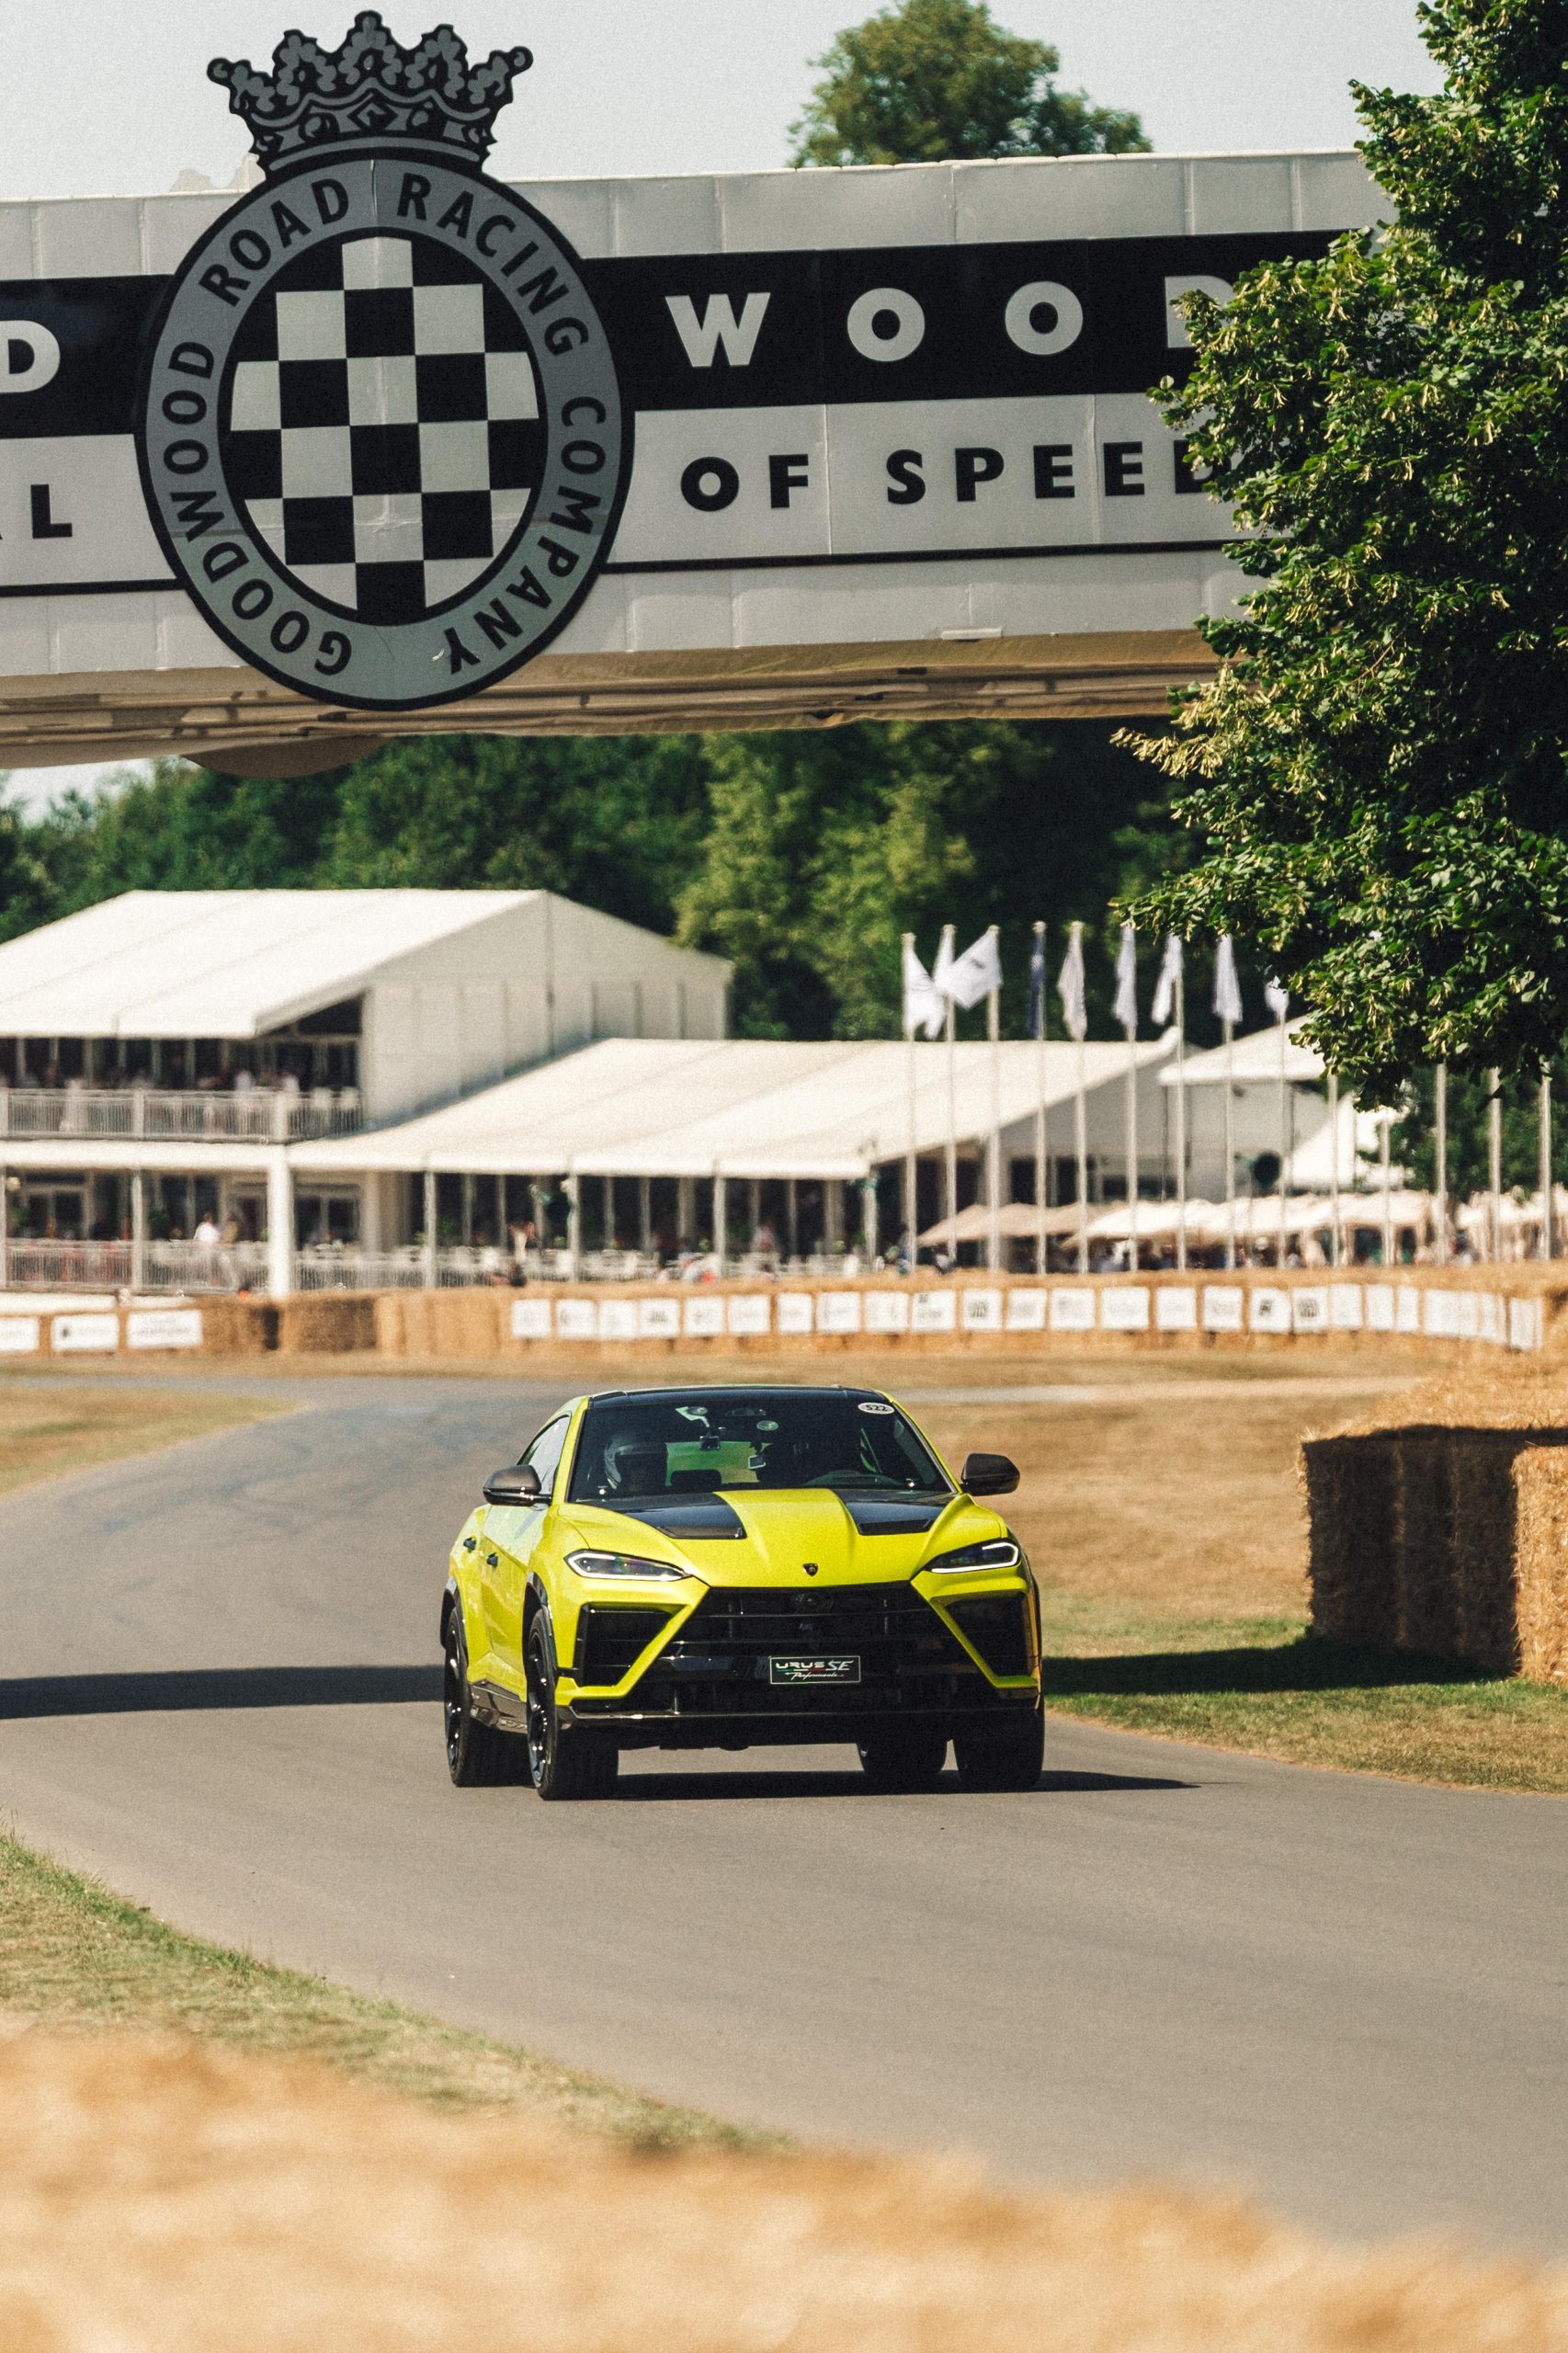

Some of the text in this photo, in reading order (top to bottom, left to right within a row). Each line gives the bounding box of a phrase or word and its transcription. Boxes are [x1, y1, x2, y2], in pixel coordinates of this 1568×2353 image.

[162, 172, 608, 677] GOODWOOD ROAD RACING COMPANY
[680, 453, 810, 512] OF
[775, 1660, 855, 1671] URUS SE
